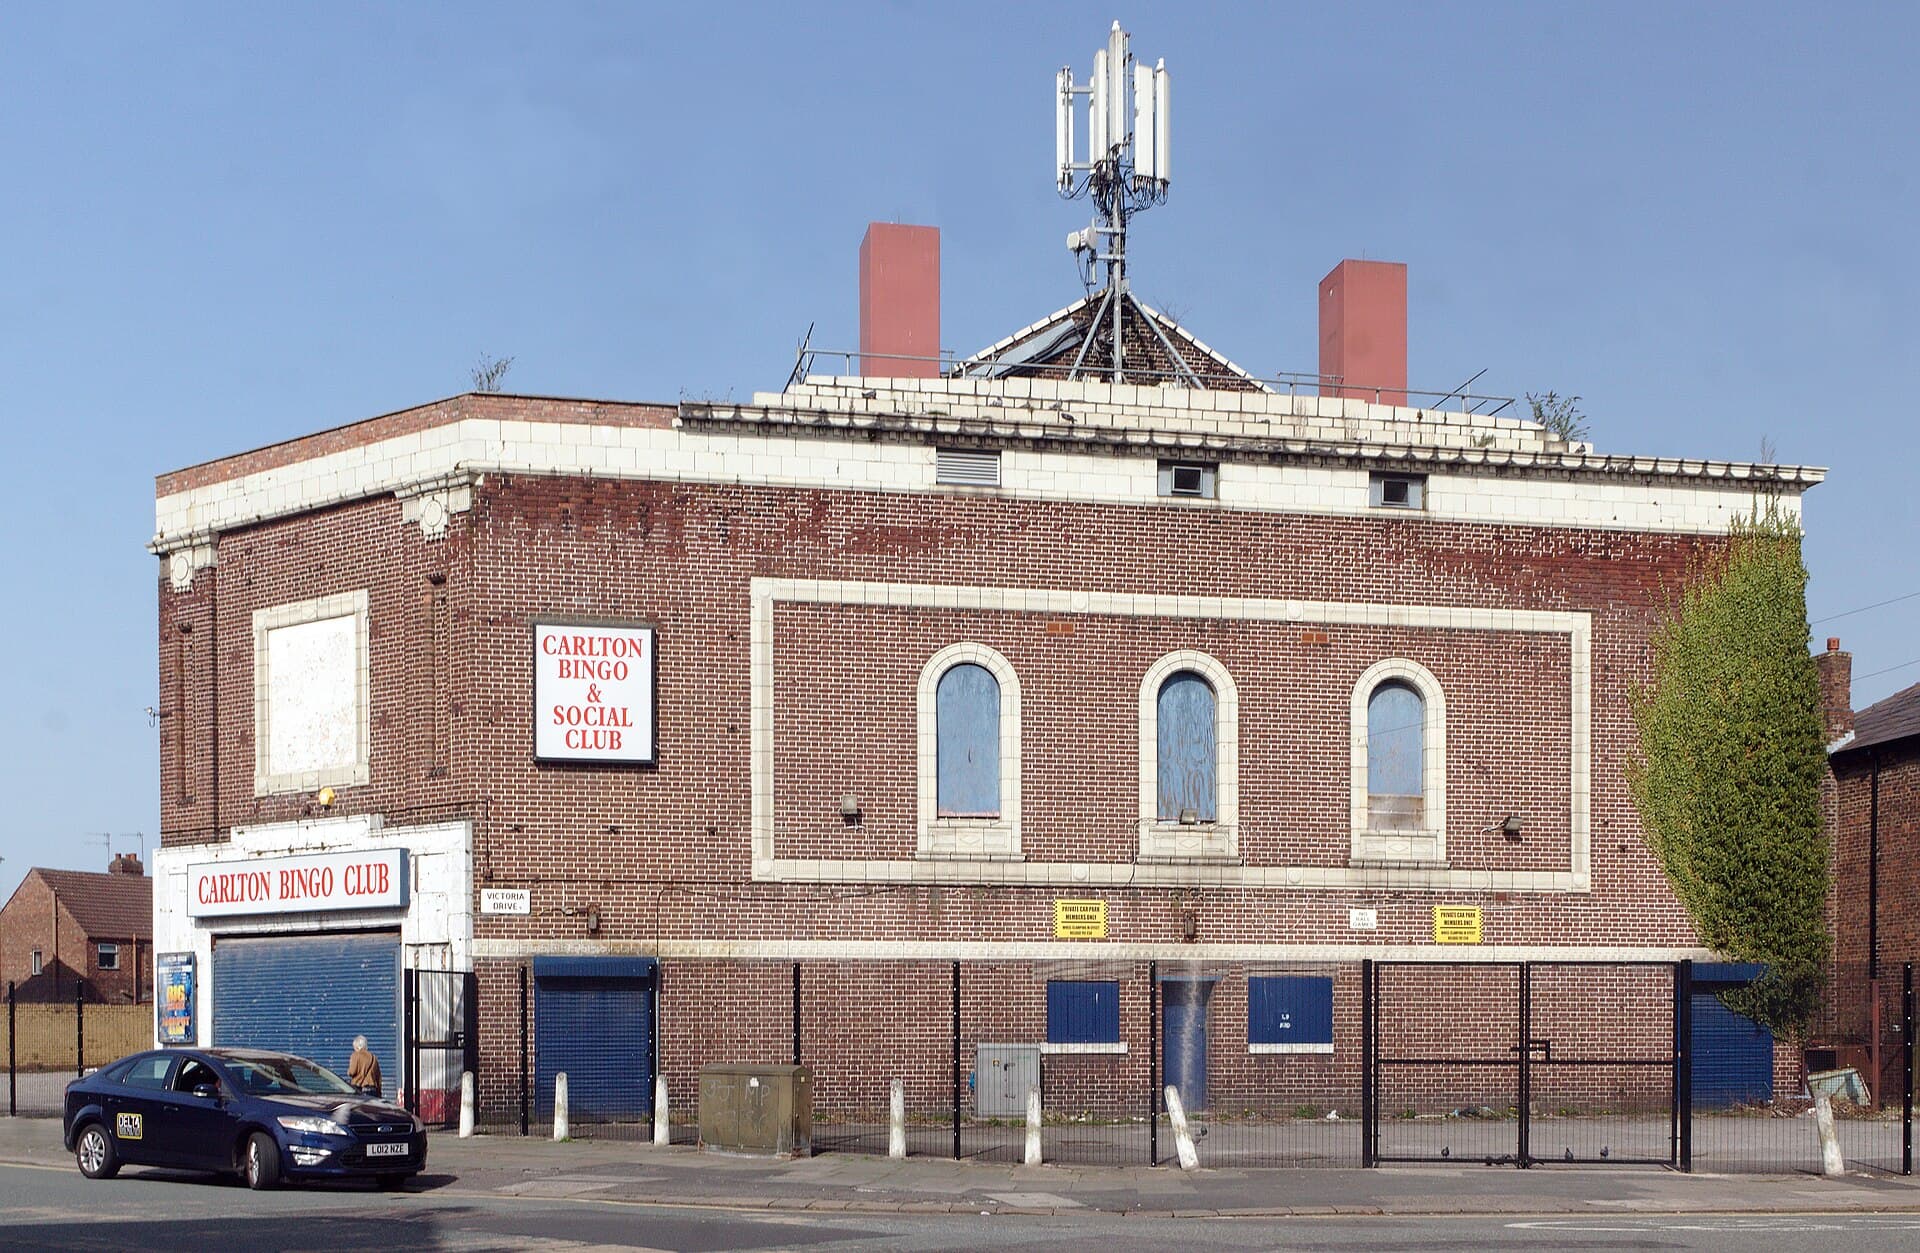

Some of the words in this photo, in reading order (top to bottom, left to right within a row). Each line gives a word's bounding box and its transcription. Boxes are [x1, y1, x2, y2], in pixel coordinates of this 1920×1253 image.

[542, 634, 643, 658] CARLTON
[558, 658, 628, 681] BINGO
[587, 683, 602, 703] &
[553, 705, 633, 727] SOCIAL
[565, 729, 622, 750] CLUB
[198, 871, 271, 905] CARLTON
[279, 867, 334, 900] BINGO
[344, 863, 389, 896] CLUB
[486, 892, 525, 900] VICTORIA
[118, 1114, 140, 1129] DELTA
[390, 1144, 404, 1153] NZE
